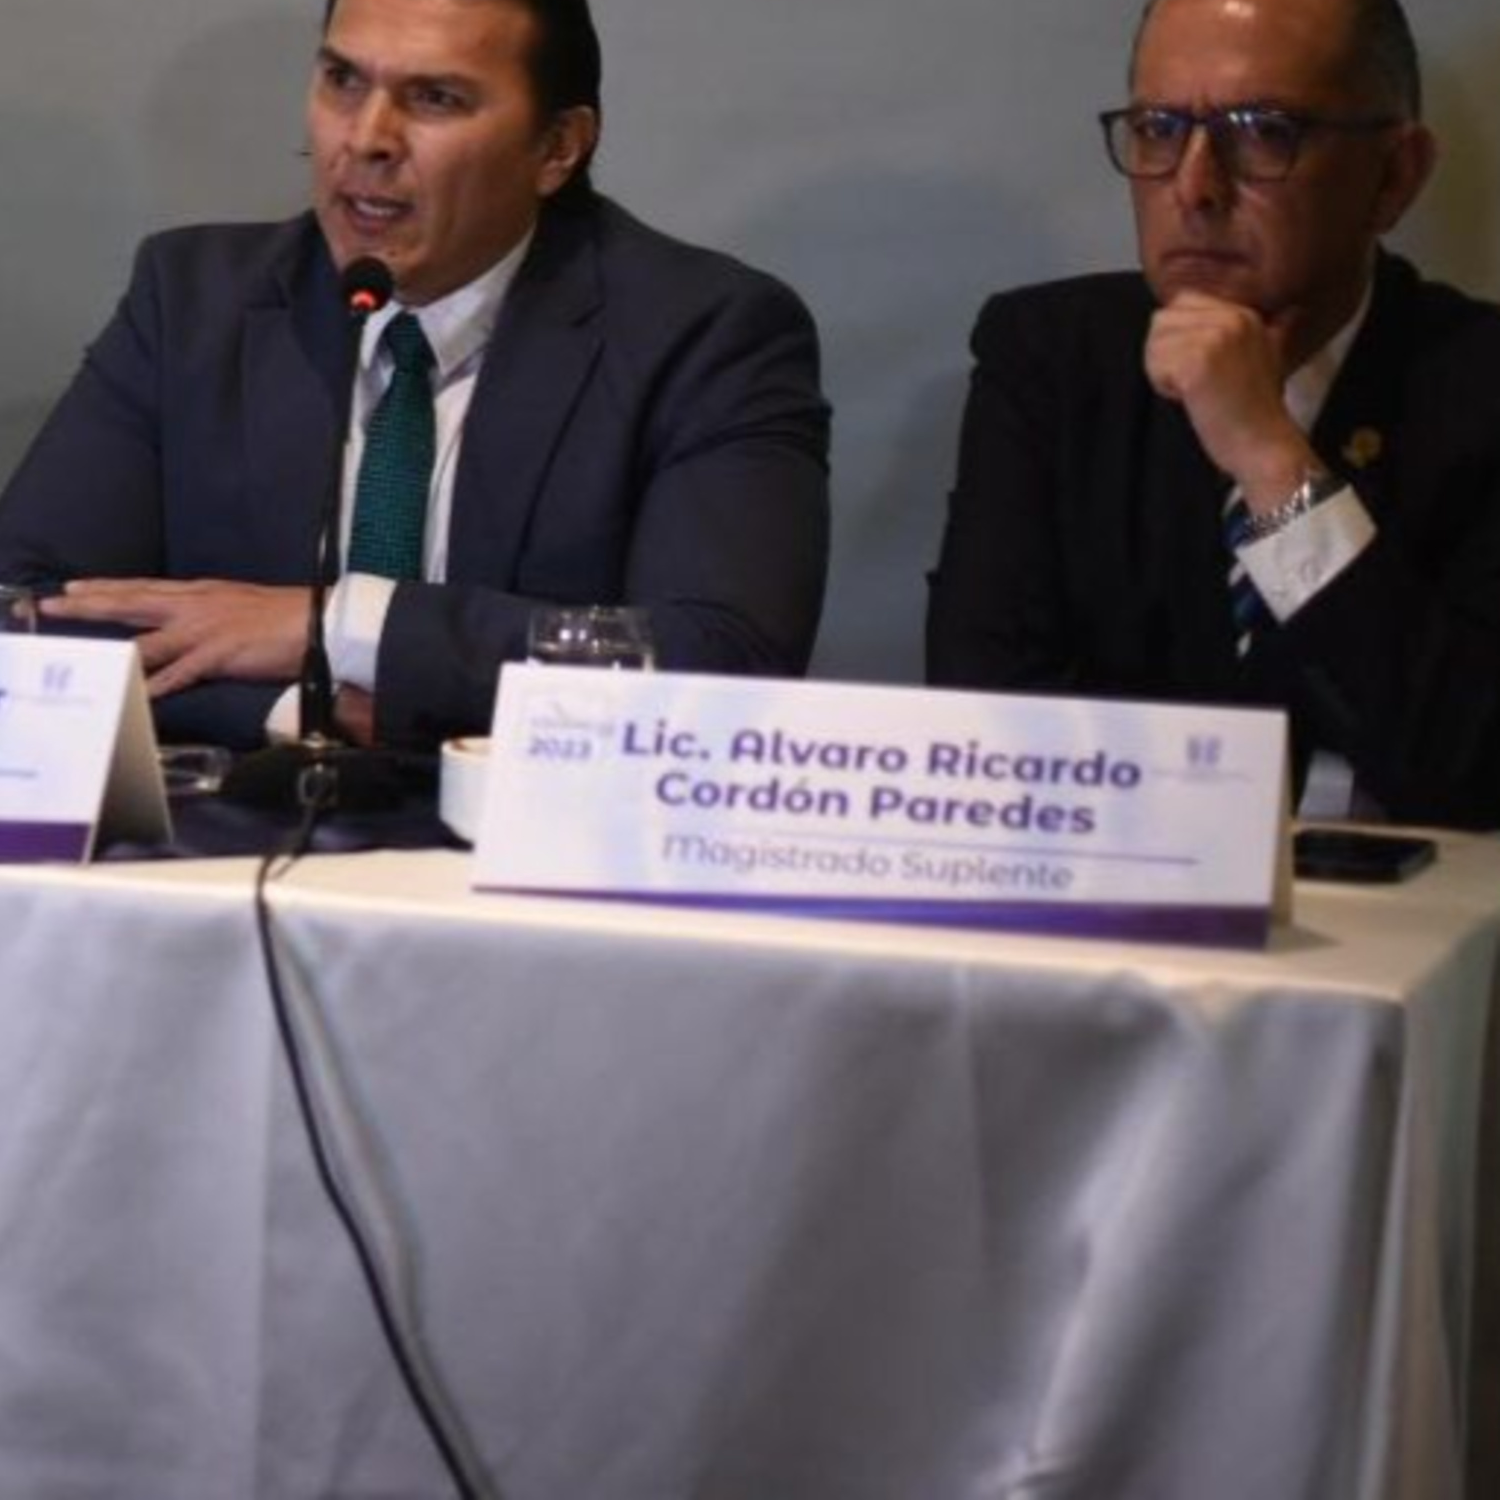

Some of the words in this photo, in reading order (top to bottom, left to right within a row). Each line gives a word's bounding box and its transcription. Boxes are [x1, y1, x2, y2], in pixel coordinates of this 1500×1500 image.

[621, 718, 711, 761] Lic.
[729, 728, 909, 773] Alvaro
[927, 740, 1143, 789] Ricardo
[654, 771, 850, 817] Cordón
[868, 786, 1096, 834] Paredes
[662, 833, 892, 878] Magistrado
[901, 850, 1075, 890] Suplente
